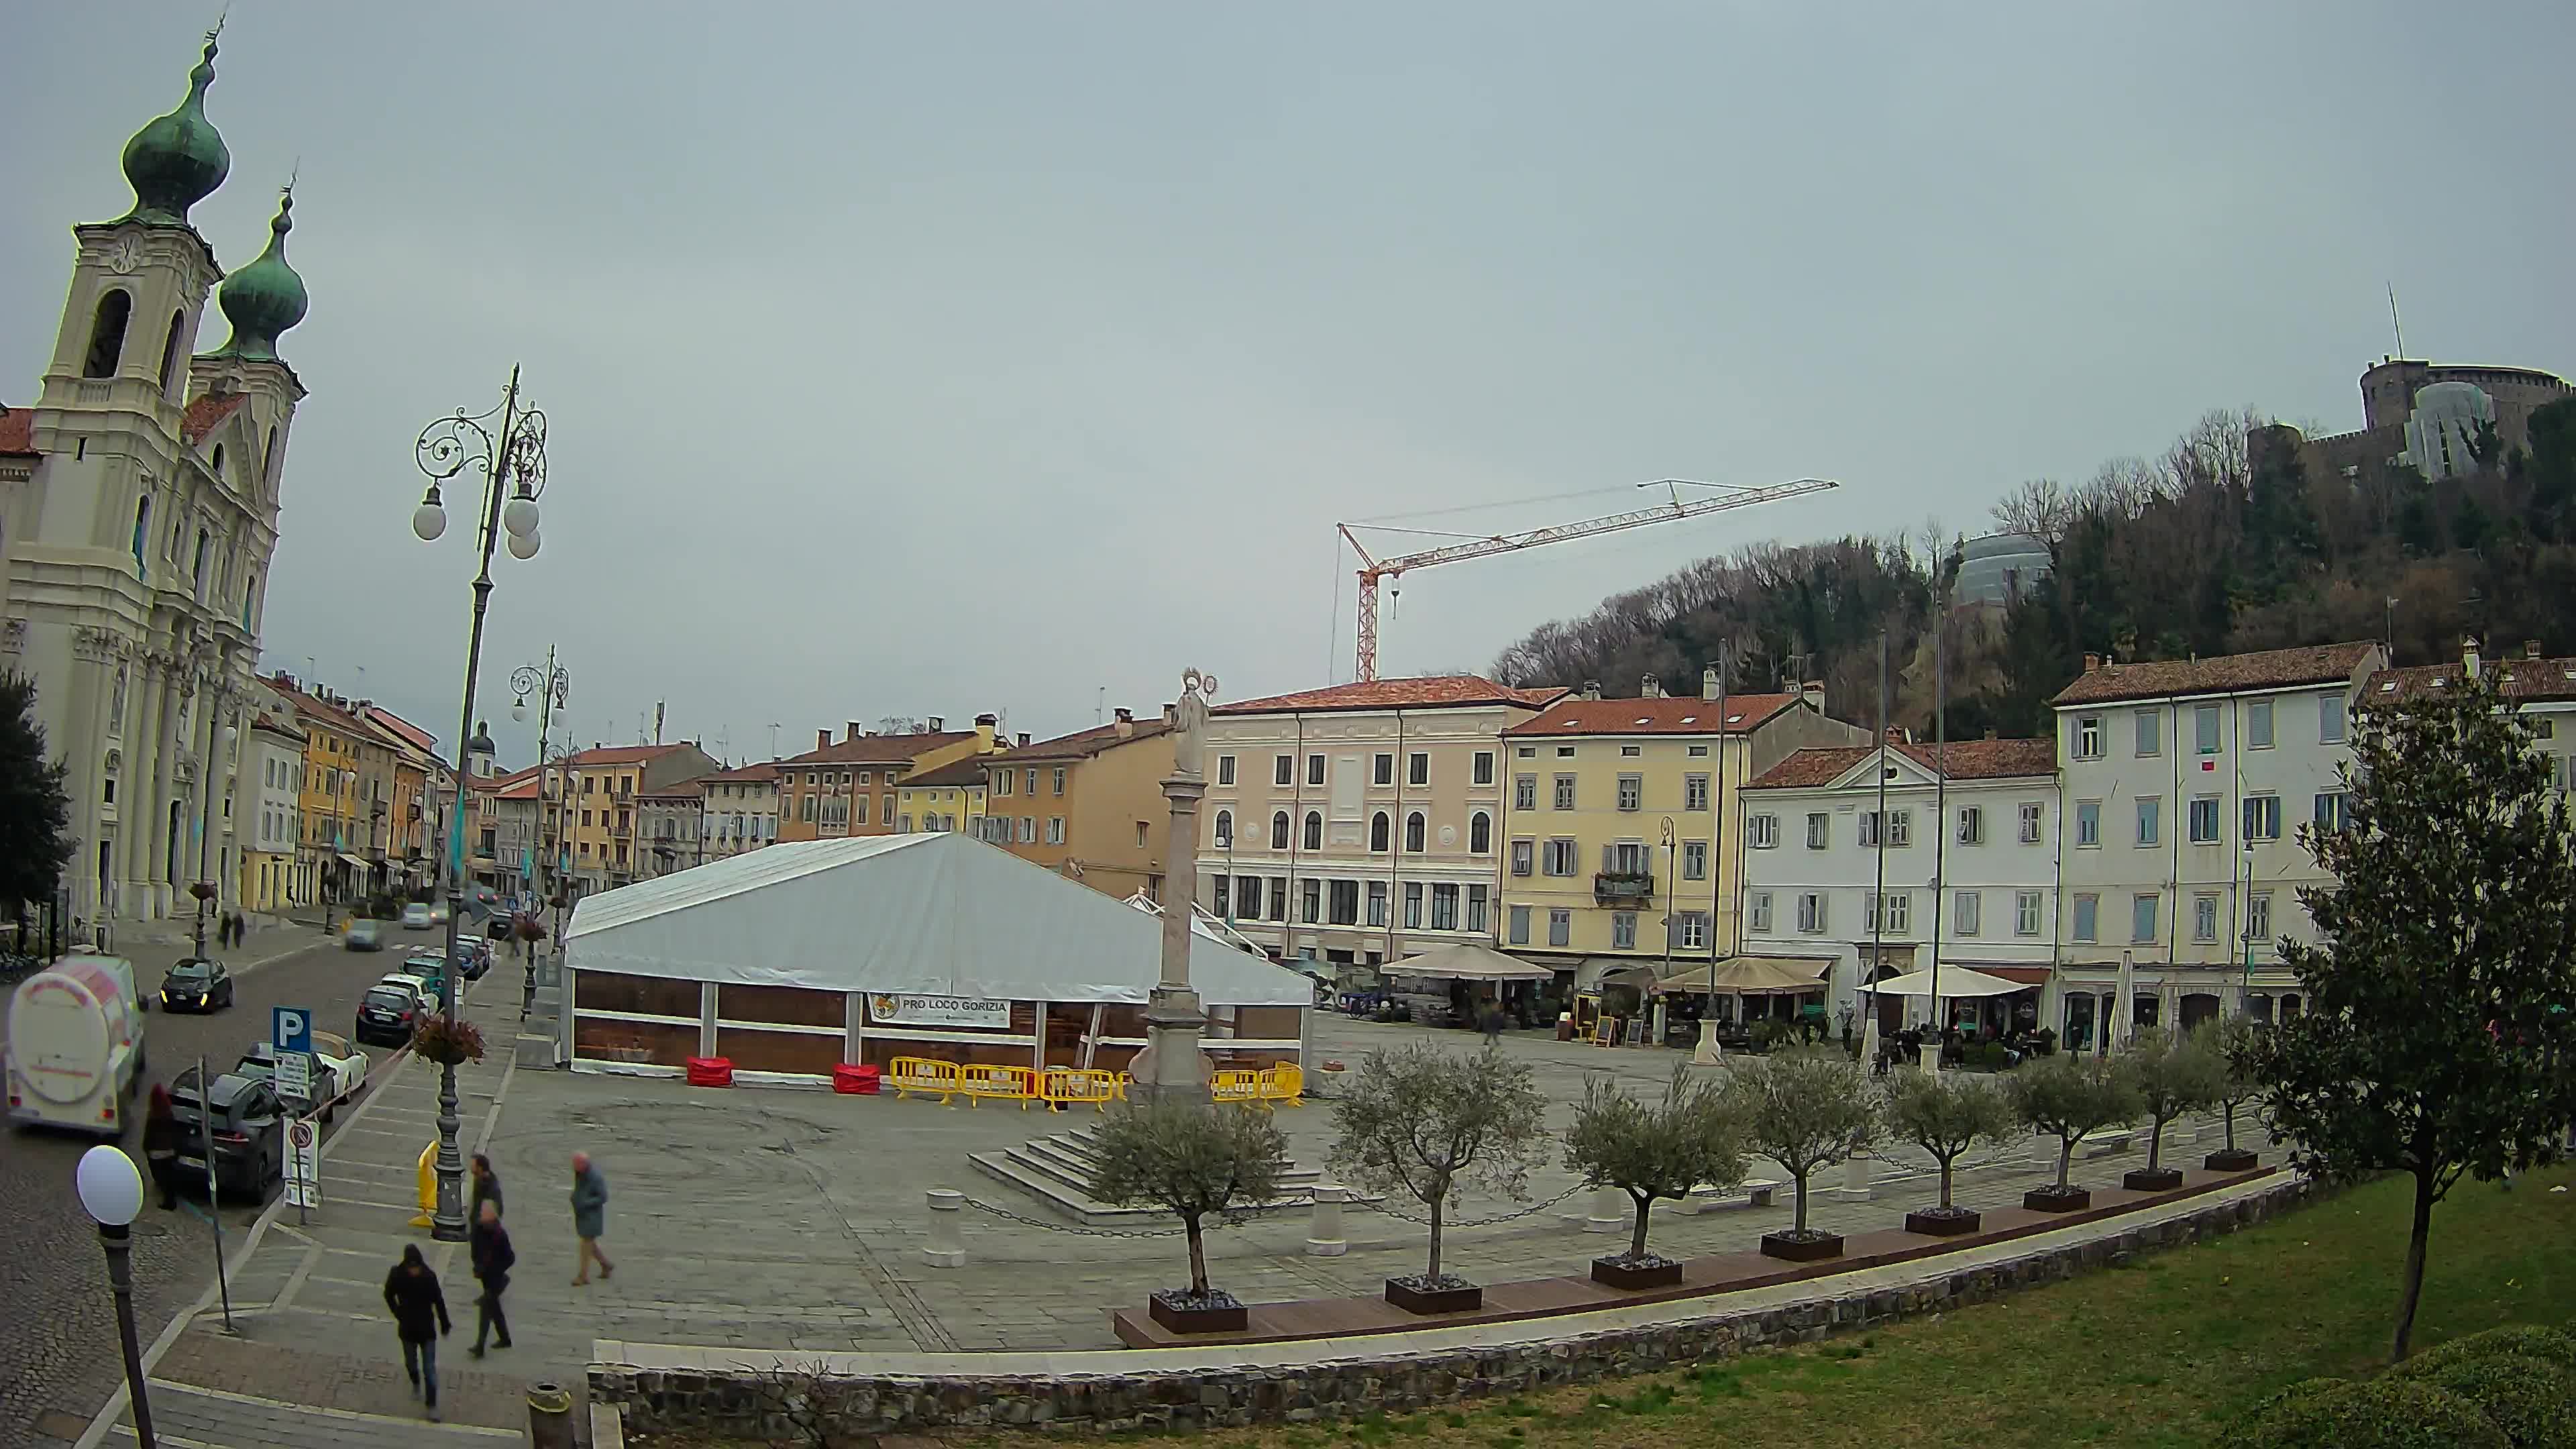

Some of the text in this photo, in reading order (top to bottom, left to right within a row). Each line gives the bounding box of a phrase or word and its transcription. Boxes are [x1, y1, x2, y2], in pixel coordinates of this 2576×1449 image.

[903, 999, 1007, 1012] PRO LOCO GORIZIA
[279, 1011, 304, 1046] P
